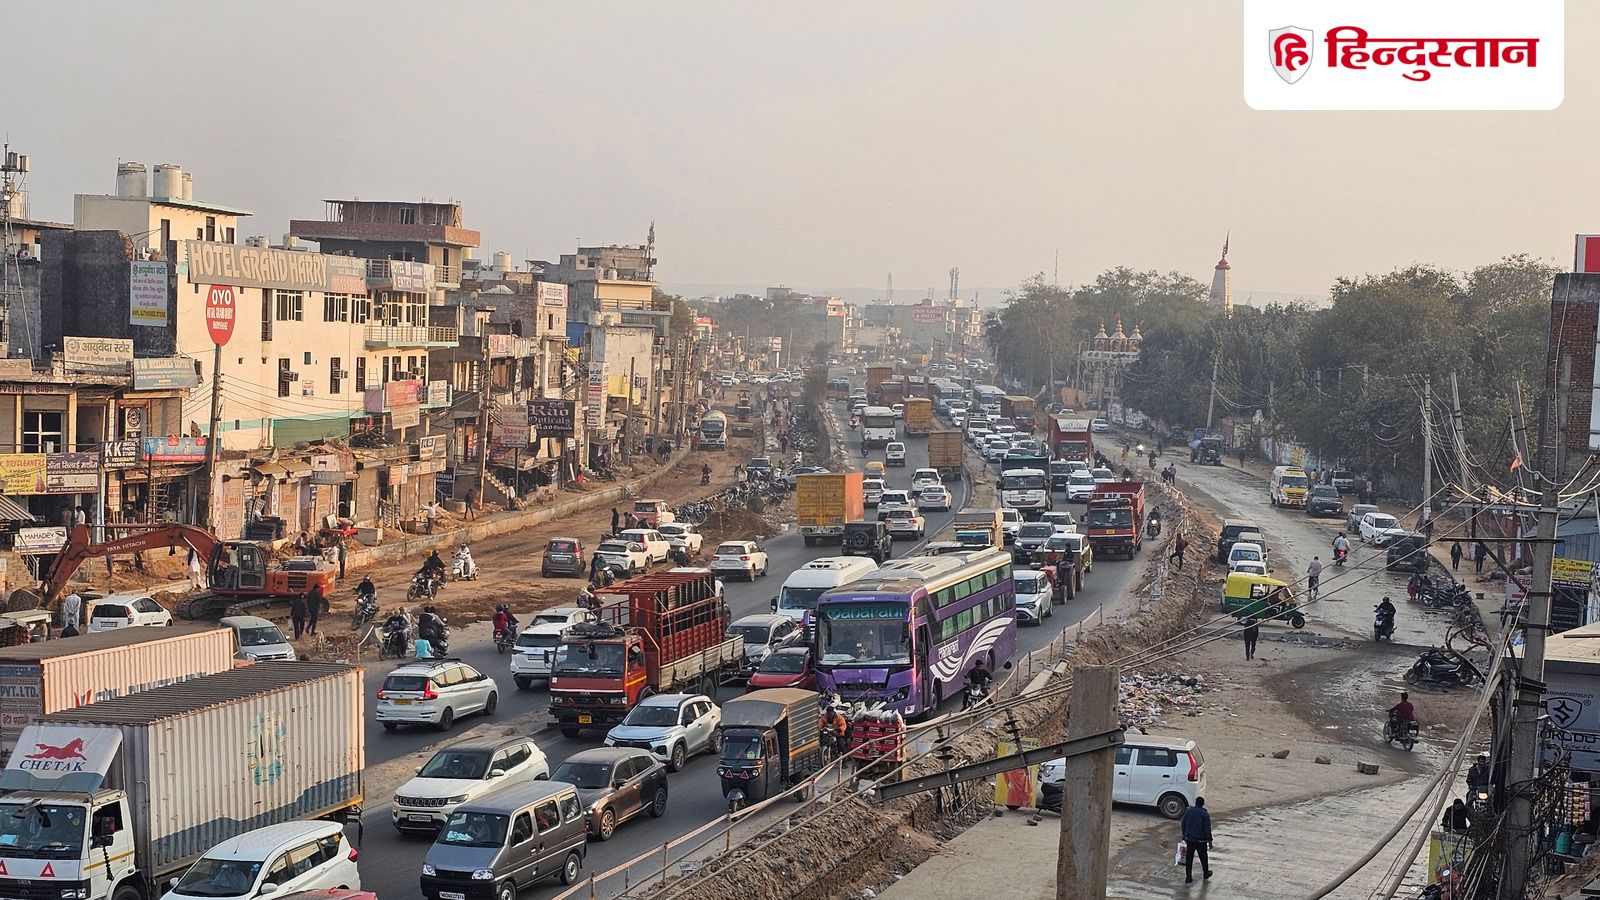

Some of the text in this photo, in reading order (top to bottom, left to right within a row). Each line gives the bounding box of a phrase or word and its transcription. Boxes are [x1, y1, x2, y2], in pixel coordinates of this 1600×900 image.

[190, 243, 240, 279] HOTEL
[239, 249, 288, 283] GRAND
[288, 252, 328, 288] HARRY
[212, 289, 231, 305] OYO
[529, 404, 569, 416] Rao
[528, 416, 571, 424] Opticals
[122, 540, 146, 549] HITACHI
[19, 759, 87, 771] CHETAK
